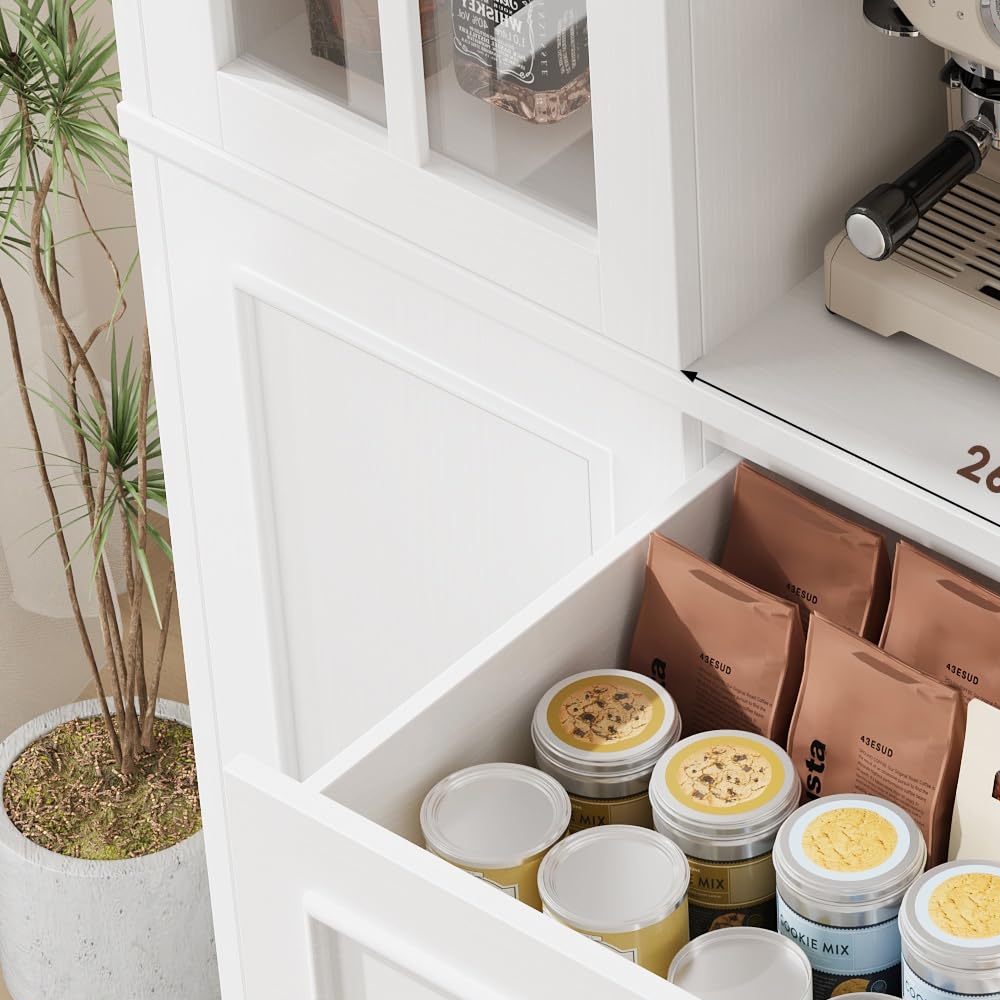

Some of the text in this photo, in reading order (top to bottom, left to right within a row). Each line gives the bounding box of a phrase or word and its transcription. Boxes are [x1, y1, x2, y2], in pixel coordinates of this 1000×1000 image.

[786, 583, 818, 605] 43ESUD
[699, 652, 732, 675] 43ESUD
[946, 663, 979, 685] 43ESUD
[860, 735, 893, 758] 43ESUD
[580, 813, 606, 826] MIX
[698, 876, 725, 890] MIX
[780, 918, 850, 956] COOKIE MIX
